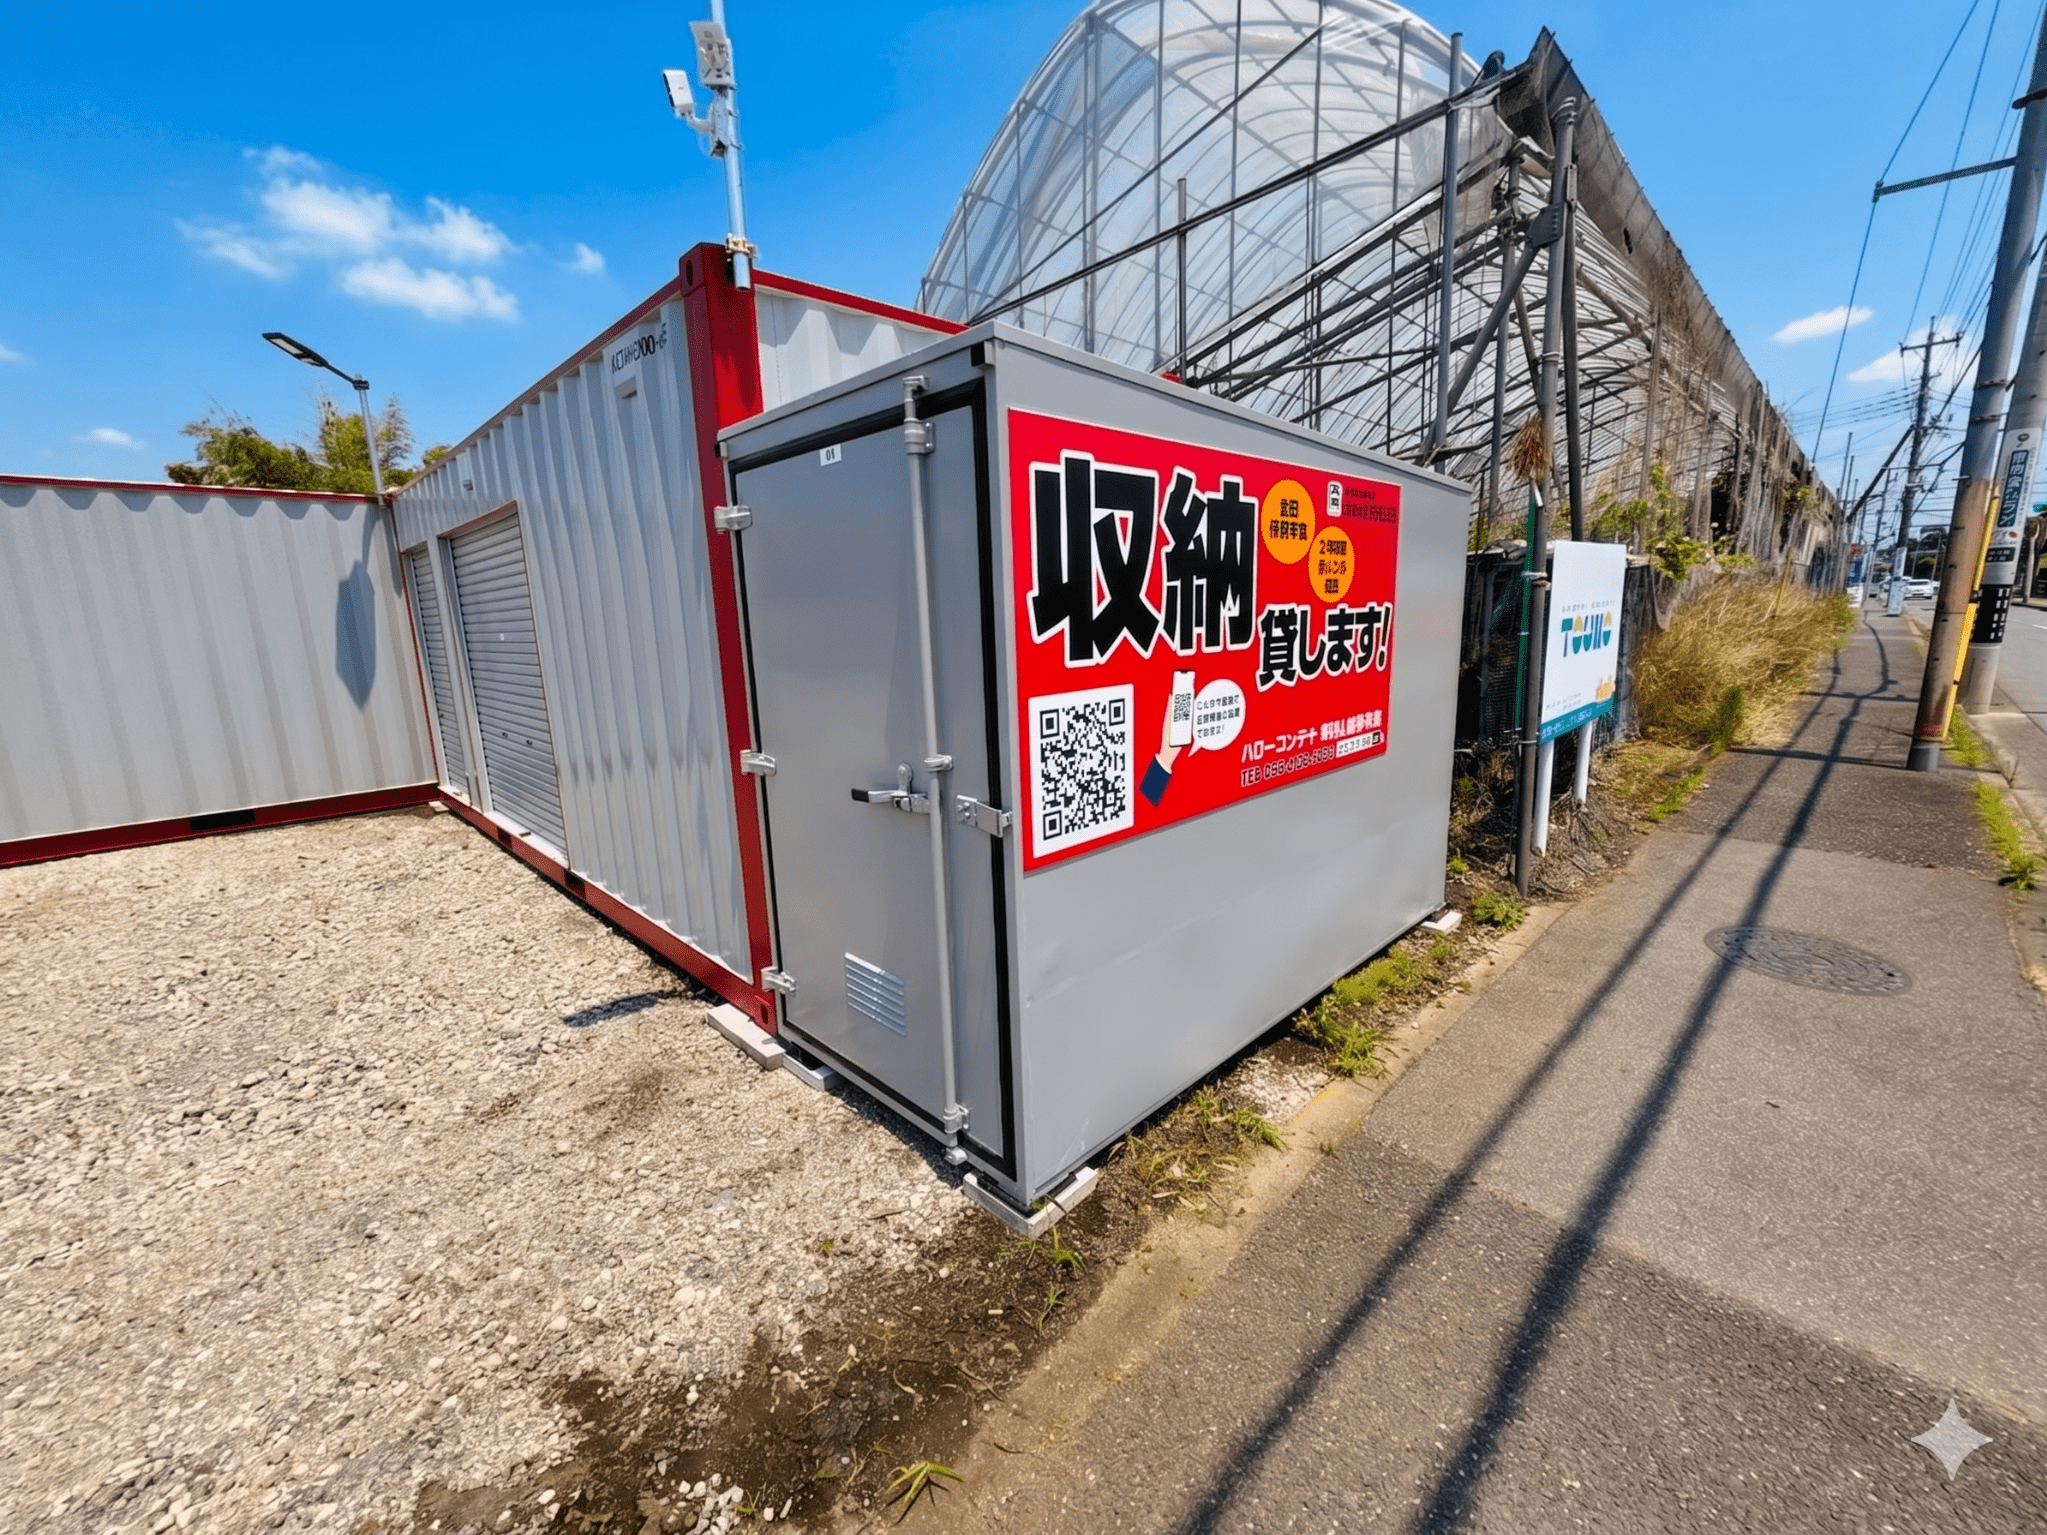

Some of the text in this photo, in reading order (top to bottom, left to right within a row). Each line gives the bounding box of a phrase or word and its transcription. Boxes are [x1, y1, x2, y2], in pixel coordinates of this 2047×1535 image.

[1030, 454, 1256, 664] 収納
[1258, 604, 1392, 689] 貸します!
[1241, 727, 1318, 763] ハローコンテナ
